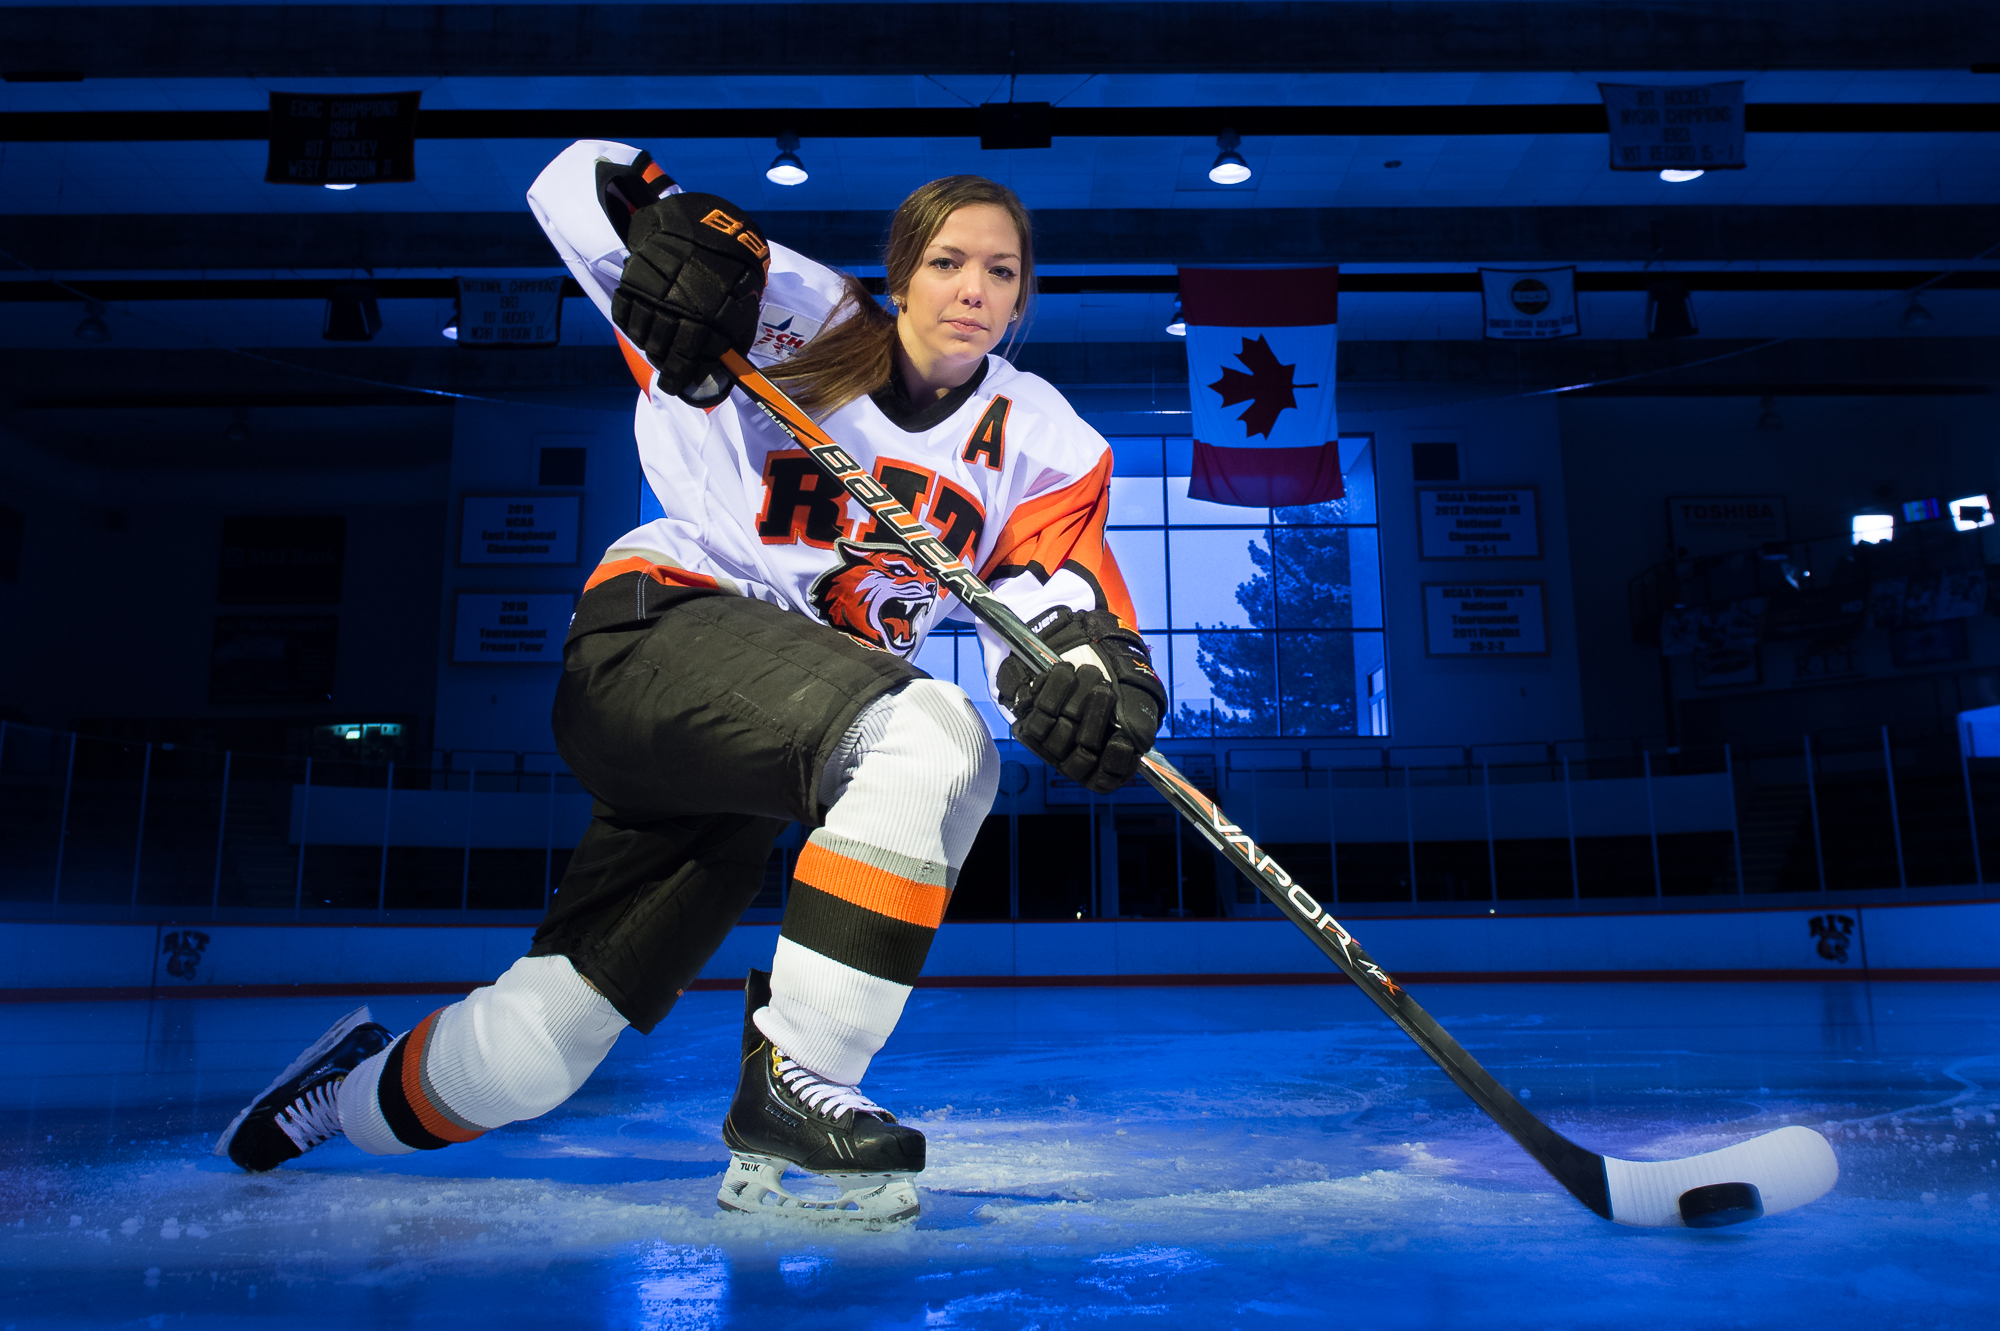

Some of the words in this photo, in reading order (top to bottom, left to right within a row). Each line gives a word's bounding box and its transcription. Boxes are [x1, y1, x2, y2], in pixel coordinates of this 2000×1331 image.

[1664, 88, 1710, 106] HOCKEY
[290, 100, 323, 118] ECAC
[331, 100, 399, 119] CHAMPIONS
[1664, 106, 1732, 124] CHAMPIONS
[305, 140, 325, 158] RIT
[331, 140, 379, 159] HOCKEY
[288, 160, 321, 179] WEST
[327, 159, 377, 179] DIVISION
[502, 311, 536, 325] HOCKEY
[756, 401, 797, 440] BAUER
[962, 394, 1011, 472] A
[1437, 493, 1465, 502] NCAA
[508, 505, 534, 515] 2010
[1435, 506, 1461, 516] 2012
[1463, 505, 1507, 515] Division
[1681, 503, 1775, 520] TOSHIBA
[506, 517, 534, 528] NCAA
[756, 448, 987, 600] RIT
[809, 443, 994, 605] BAUER
[1456, 519, 1502, 529] National
[482, 531, 505, 541] East
[507, 530, 556, 542] Regional
[1449, 532, 1511, 543] Champions
[291, 547, 338, 565] Bank
[487, 543, 550, 555] Champions
[502, 601, 528, 612] 2010
[499, 615, 529, 625] NCAA
[1451, 614, 1519, 625] Tournament
[479, 628, 547, 639] Tournament
[480, 641, 516, 652] Frozen
[519, 641, 544, 652] Four
[1212, 802, 1353, 969] VAPOR
[1809, 914, 1855, 939] RIT
[763, 1102, 801, 1129] BAUER
